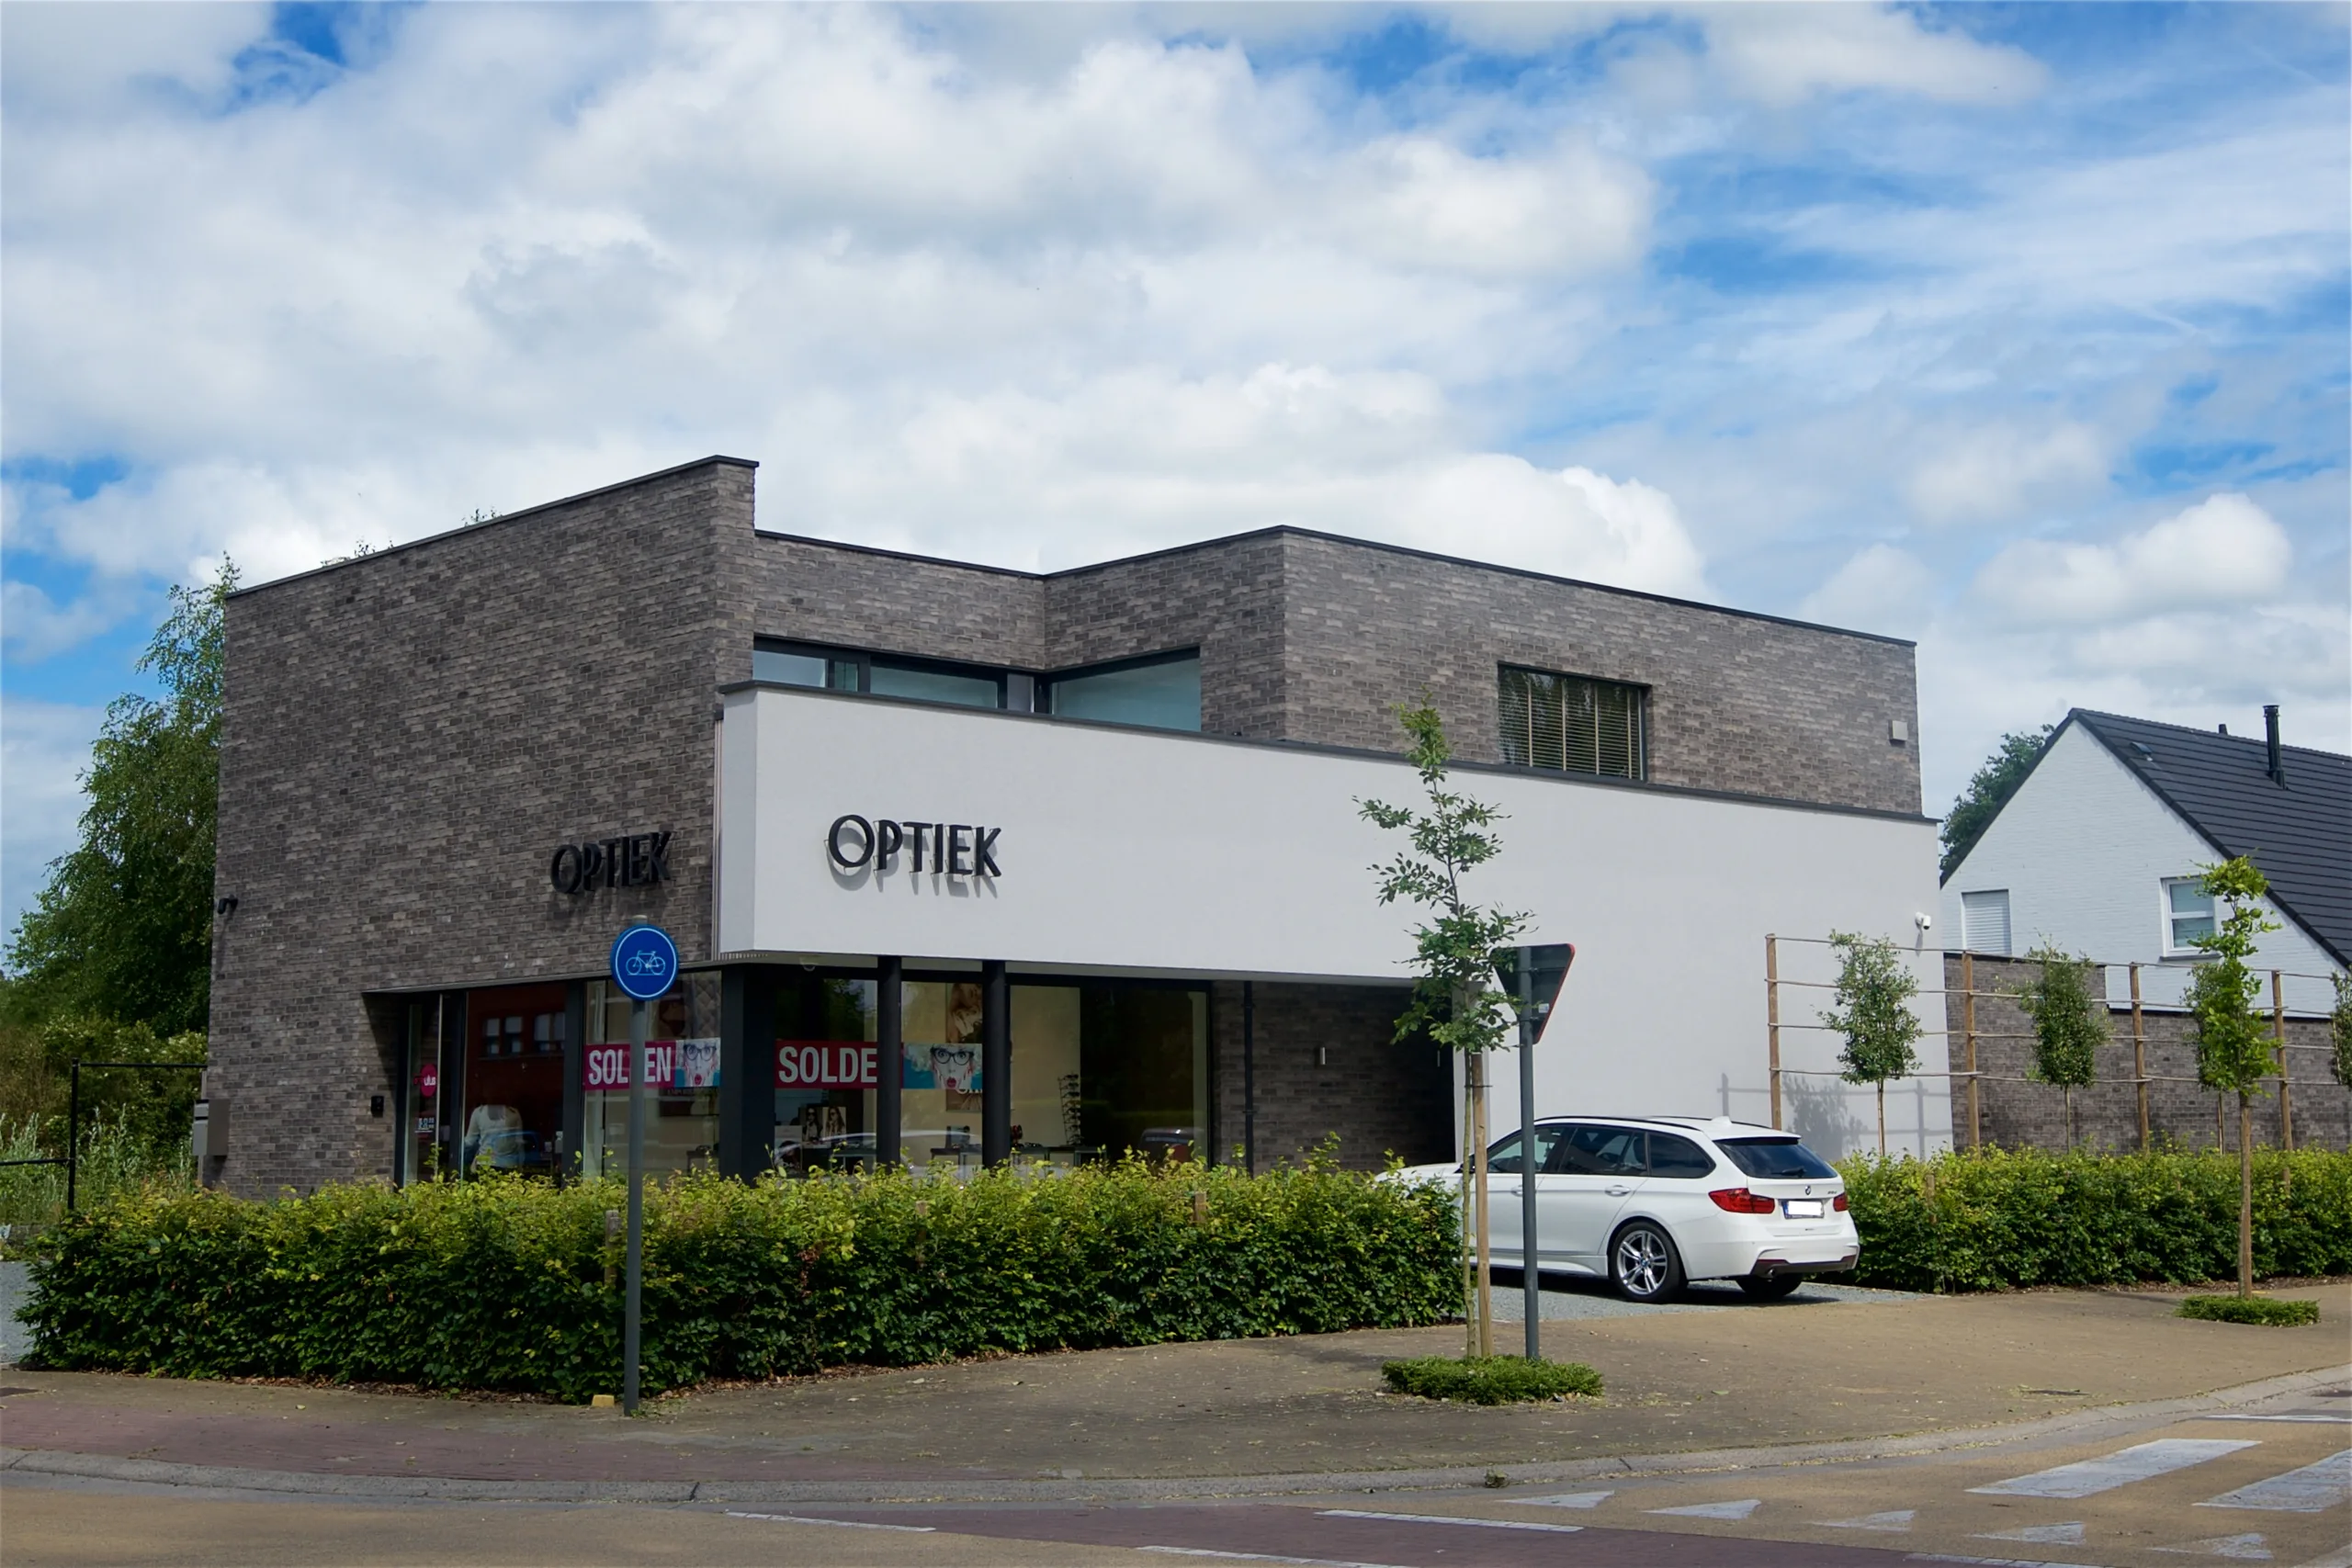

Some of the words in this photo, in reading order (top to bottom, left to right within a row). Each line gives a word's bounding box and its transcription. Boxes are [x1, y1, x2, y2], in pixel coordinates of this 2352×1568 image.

[550, 830, 673, 894] OPTIEK
[829, 814, 1001, 877] OPTIEK
[588, 1046, 672, 1085] SOLEN
[778, 1046, 878, 1083] SOLDE
